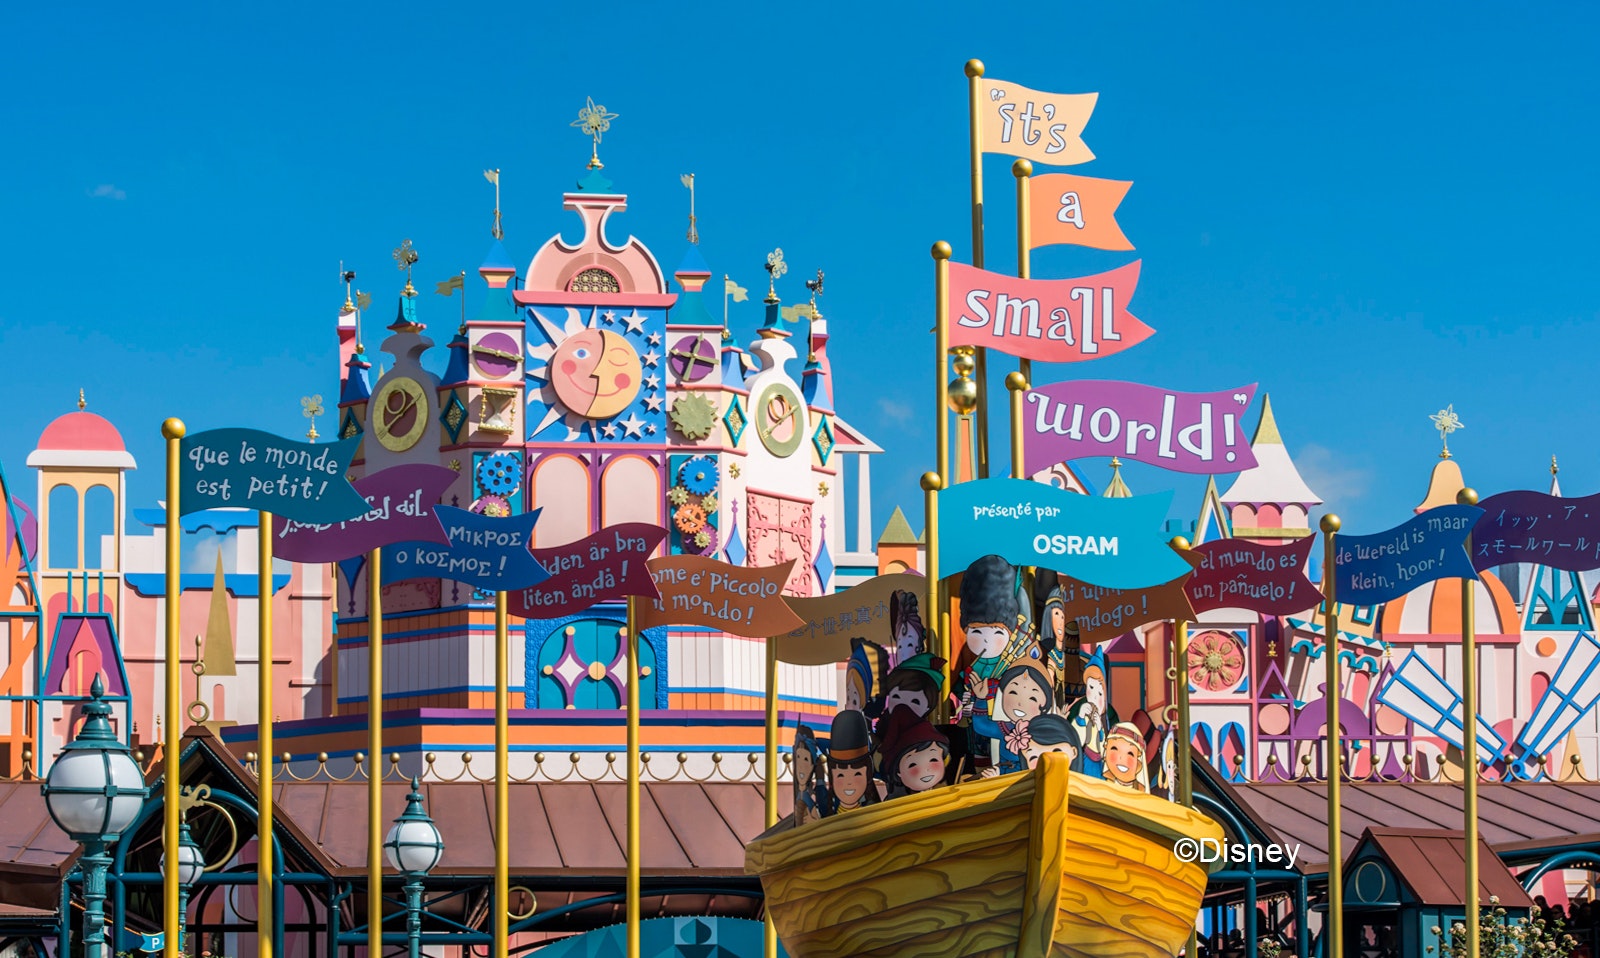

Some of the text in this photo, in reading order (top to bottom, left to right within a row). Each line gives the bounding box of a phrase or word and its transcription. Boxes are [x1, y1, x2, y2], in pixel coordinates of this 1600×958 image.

[1056, 191, 1086, 230] a
[957, 286, 1122, 354] small
[188, 441, 338, 475] que le monde
[196, 478, 231, 500] est
[973, 502, 1061, 522] présenté par
[589, 542, 610, 561] är
[614, 530, 647, 553] bra
[1033, 534, 1119, 556] OSRAM
[1336, 547, 1353, 565] de
[1412, 528, 1425, 544] is
[1427, 516, 1469, 533] maar
[1218, 551, 1275, 572] mundo
[1279, 551, 1297, 568] es
[651, 568, 687, 584] ome
[523, 588, 568, 610] liten
[1193, 584, 1215, 600] un
